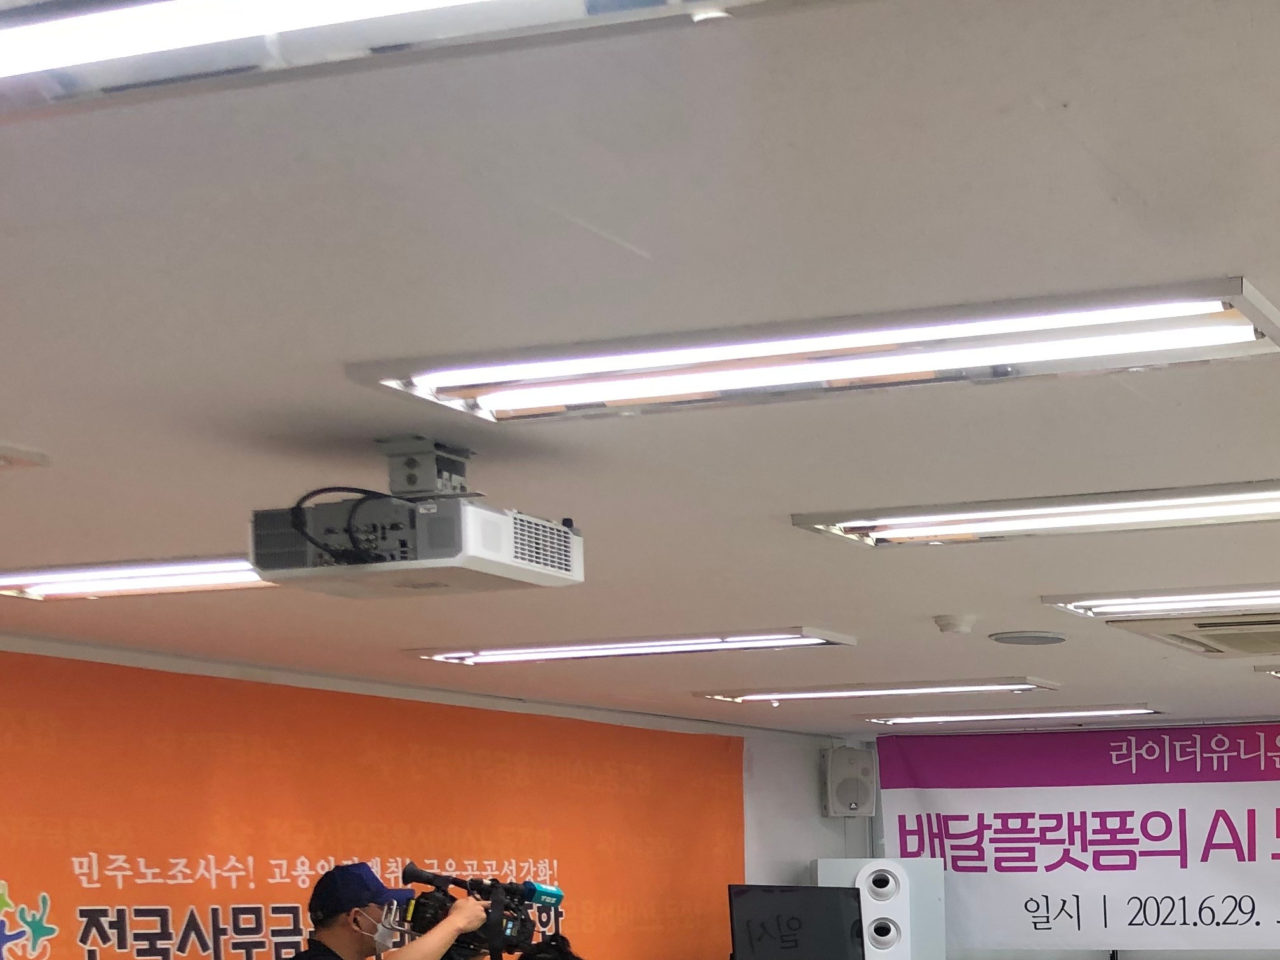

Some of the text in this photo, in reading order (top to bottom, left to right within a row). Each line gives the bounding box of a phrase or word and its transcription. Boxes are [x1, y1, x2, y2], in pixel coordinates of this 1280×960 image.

[898, 808, 1188, 874] 배달플랫폼의
[1200, 808, 1257, 864] AI
[71, 852, 256, 890] 민주노조사수!
[1023, 893, 1082, 932] 일시
[1127, 894, 1260, 928] 2021.6.29.
